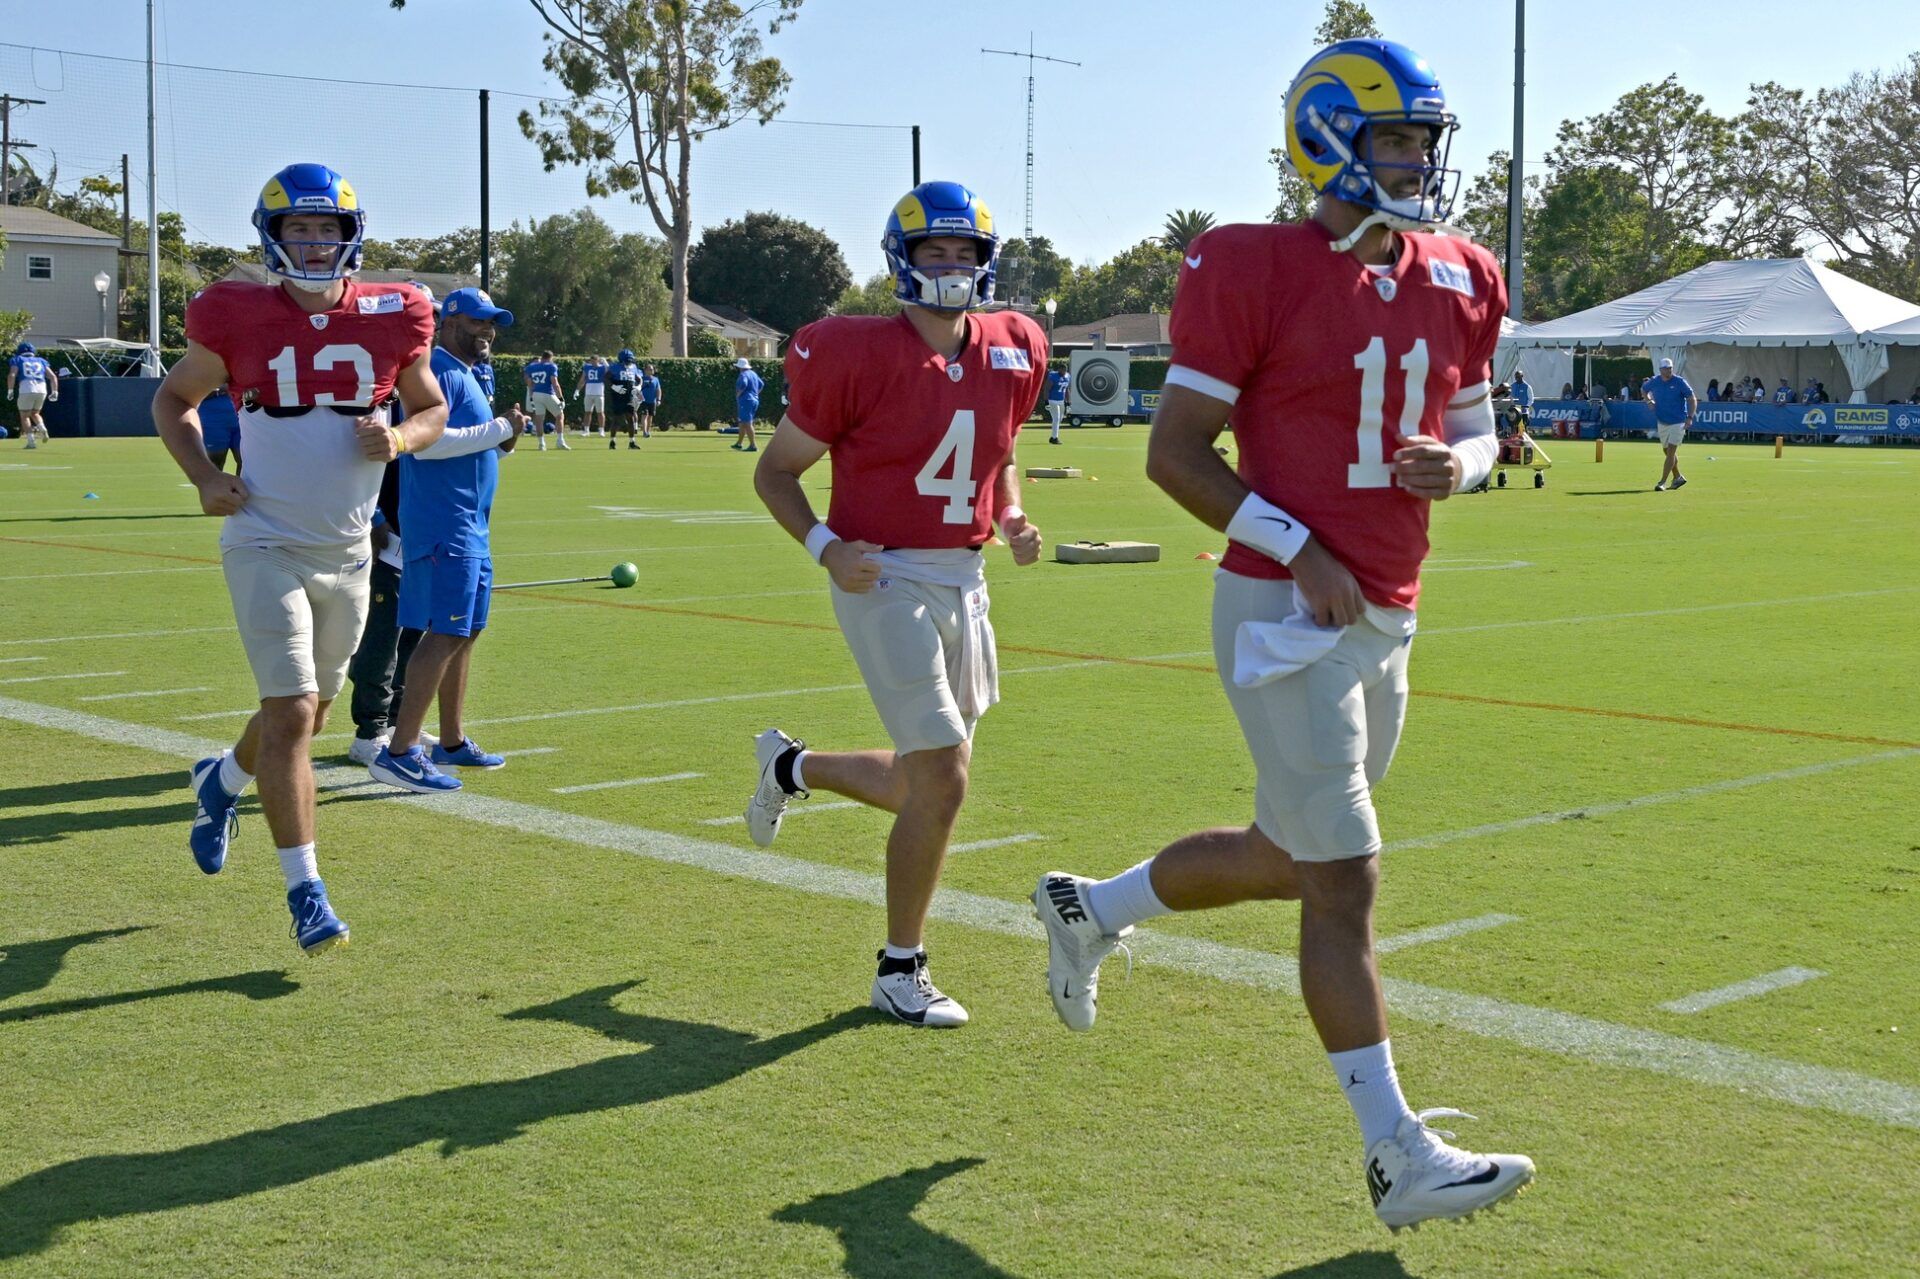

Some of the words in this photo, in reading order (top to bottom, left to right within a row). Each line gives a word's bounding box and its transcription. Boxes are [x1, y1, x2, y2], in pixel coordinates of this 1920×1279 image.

[268, 343, 375, 407] 13
[587, 369, 599, 381] 61
[1348, 336, 1430, 489] 11
[1694, 410, 1748, 424] YUNDAI
[1836, 411, 1886, 423] RAMS
[914, 409, 977, 525] 4
[1046, 877, 1088, 925] NIKE
